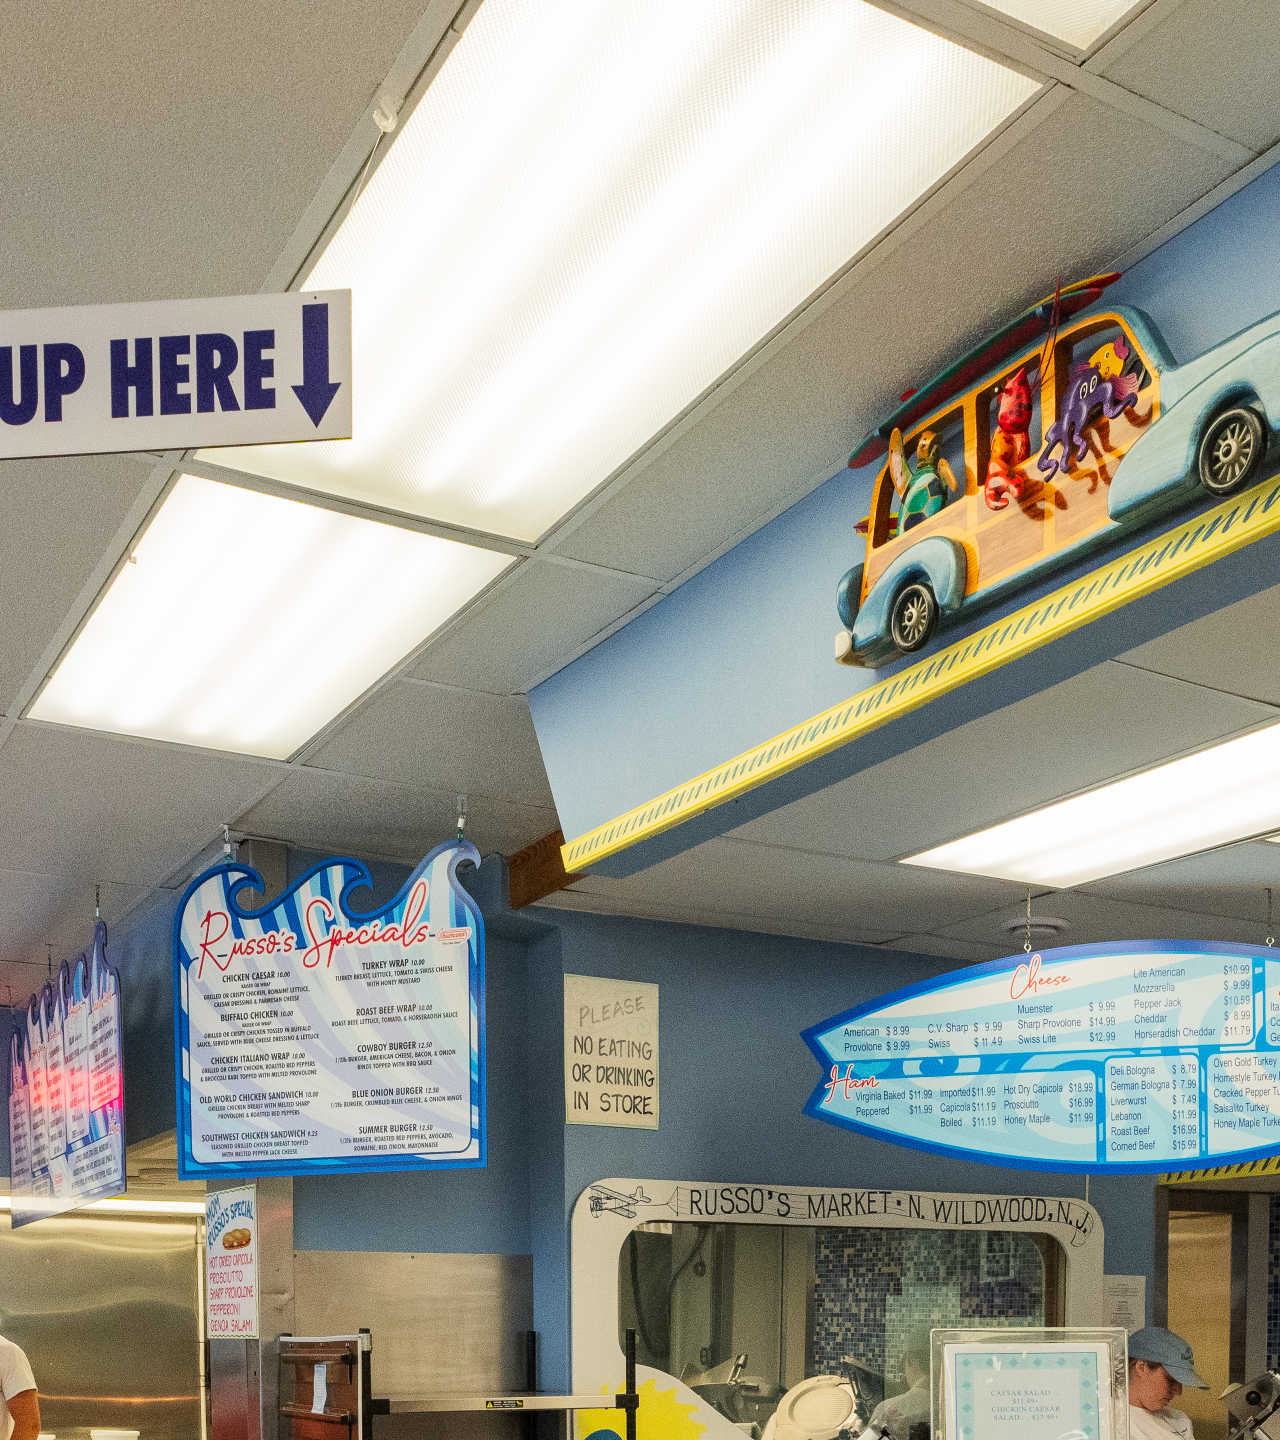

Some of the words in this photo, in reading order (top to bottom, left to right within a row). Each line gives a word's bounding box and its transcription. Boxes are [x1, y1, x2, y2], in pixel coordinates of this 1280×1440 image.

[110, 329, 276, 418] HERE
[198, 909, 295, 979] Russo's
[302, 881, 429, 968] Specials
[362, 960, 388, 971] TURKEY
[389, 959, 409, 968] WRAP
[222, 972, 250, 983] CHICKEN
[251, 970, 275, 980] CAESAR
[1010, 955, 1071, 1000] Cheese
[1150, 967, 1185, 977] American
[1133, 983, 1175, 993] Mozzarella
[356, 1007, 377, 1017] ROAST
[378, 1005, 395, 1014] BEEF
[396, 1004, 416, 1013] WRAP
[578, 995, 645, 1027] PLEASE
[1018, 1004, 1053, 1015] Muenster
[1134, 999, 1162, 1010] Pepper
[220, 1011, 249, 1022] BUFFALO
[250, 1009, 278, 1019] CHICKEN
[1134, 1014, 1167, 1024] Cheddar
[1043, 1018, 1081, 1028] Provolone
[844, 1028, 880, 1037] American
[1134, 1029, 1180, 1040] Horseradish
[1183, 1027, 1216, 1038] Cheddar
[357, 1042, 387, 1053] COWBOY
[389, 1041, 416, 1051] BURGER
[573, 1035, 594, 1056] NO
[597, 1034, 653, 1061] EATING
[844, 1042, 882, 1052] Provolone
[211, 1055, 238, 1065] CHICKEN
[239, 1053, 269, 1063] ITALIANO
[271, 1052, 290, 1061] WRAP
[1253, 1056, 1277, 1068] Turkey
[572, 1063, 592, 1084] OR
[595, 1064, 655, 1088] DRINKING
[1126, 1065, 1156, 1077] Bologna
[825, 1063, 880, 1102] Ham
[1141, 1081, 1170, 1093] Bologna
[199, 1095, 212, 1104] OLD
[213, 1094, 237, 1104] WORLD
[239, 1092, 267, 1103] CHICKEN
[268, 1091, 304, 1101] SANDWICH
[352, 1089, 369, 1098] BLUE
[370, 1088, 394, 1097] ONION
[395, 1086, 423, 1096] BURGER
[883, 1090, 906, 1101] Baked
[573, 1091, 589, 1111] IN
[599, 1092, 654, 1116] STORE
[1110, 1095, 1147, 1106] Liverwurst
[856, 1106, 890, 1117] Peppered
[1245, 1102, 1270, 1114] Turkey
[201, 1132, 239, 1143] SOUTHWEST
[241, 1130, 269, 1141] CHICKEN
[270, 1129, 306, 1139] SANDWICH
[358, 1125, 388, 1135] SUMMER
[390, 1124, 417, 1133] BURGER
[229, 1199, 254, 1221] SPECIAL
[688, 1187, 793, 1218] RUSSO'S
[807, 1191, 892, 1219] MARKET
[907, 1194, 927, 1220] N.
[932, 1195, 1054, 1224] WILDWOOD,
[209, 1269, 243, 1286] PROSCIUTTO
[224, 1285, 254, 1299] PROVOLONE
[210, 1302, 241, 1316] PEPPERONI
[210, 1319, 229, 1333] GENOA
[230, 1319, 253, 1333] SALAMI
